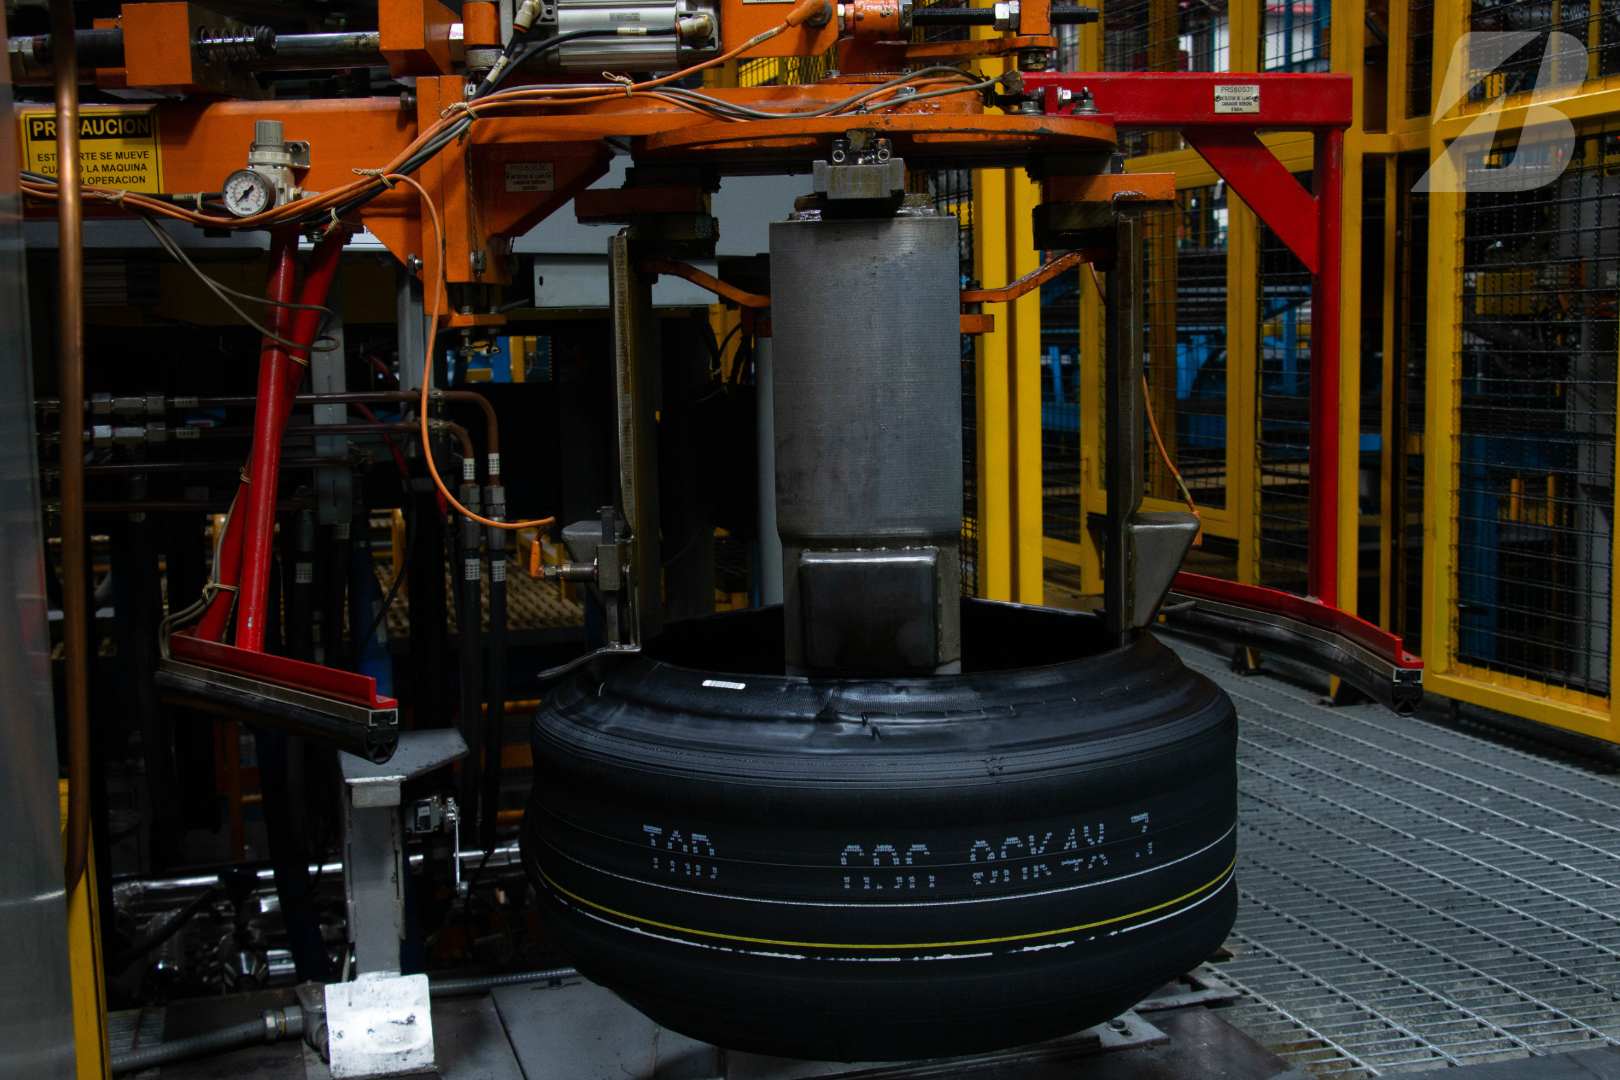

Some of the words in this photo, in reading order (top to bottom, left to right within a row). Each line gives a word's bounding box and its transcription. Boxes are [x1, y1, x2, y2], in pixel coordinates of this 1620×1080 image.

[33, 117, 150, 137] PRAUCION
[99, 151, 113, 160] SE
[115, 150, 150, 160] MUEVE
[86, 164, 99, 173] LA
[101, 163, 148, 173] MAQUINA
[87, 175, 146, 185] OPERACION
